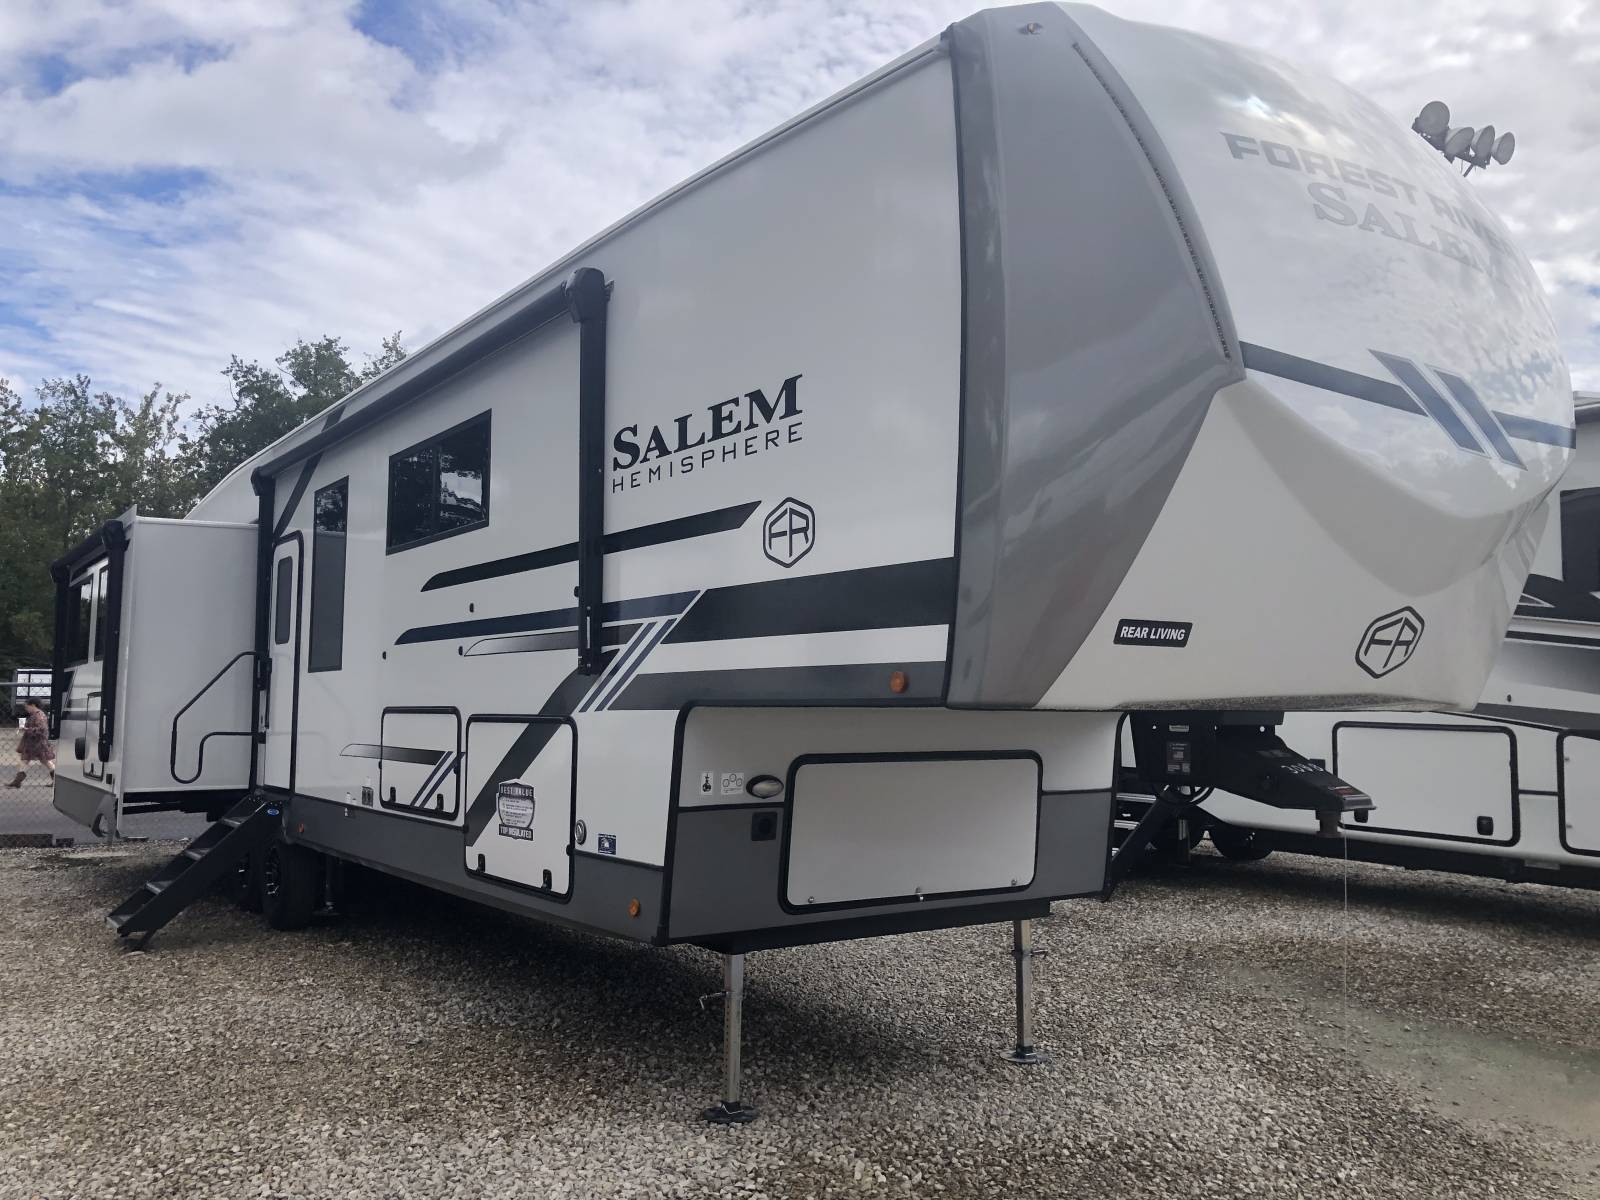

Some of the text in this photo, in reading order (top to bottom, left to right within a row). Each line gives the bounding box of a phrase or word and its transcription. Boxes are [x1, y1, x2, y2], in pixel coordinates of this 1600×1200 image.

[1221, 133, 1418, 206] FOREST
[613, 374, 803, 471] SALEM
[613, 422, 803, 493] HEMISPHERE
[1120, 626, 1186, 641] REAR LIVING
